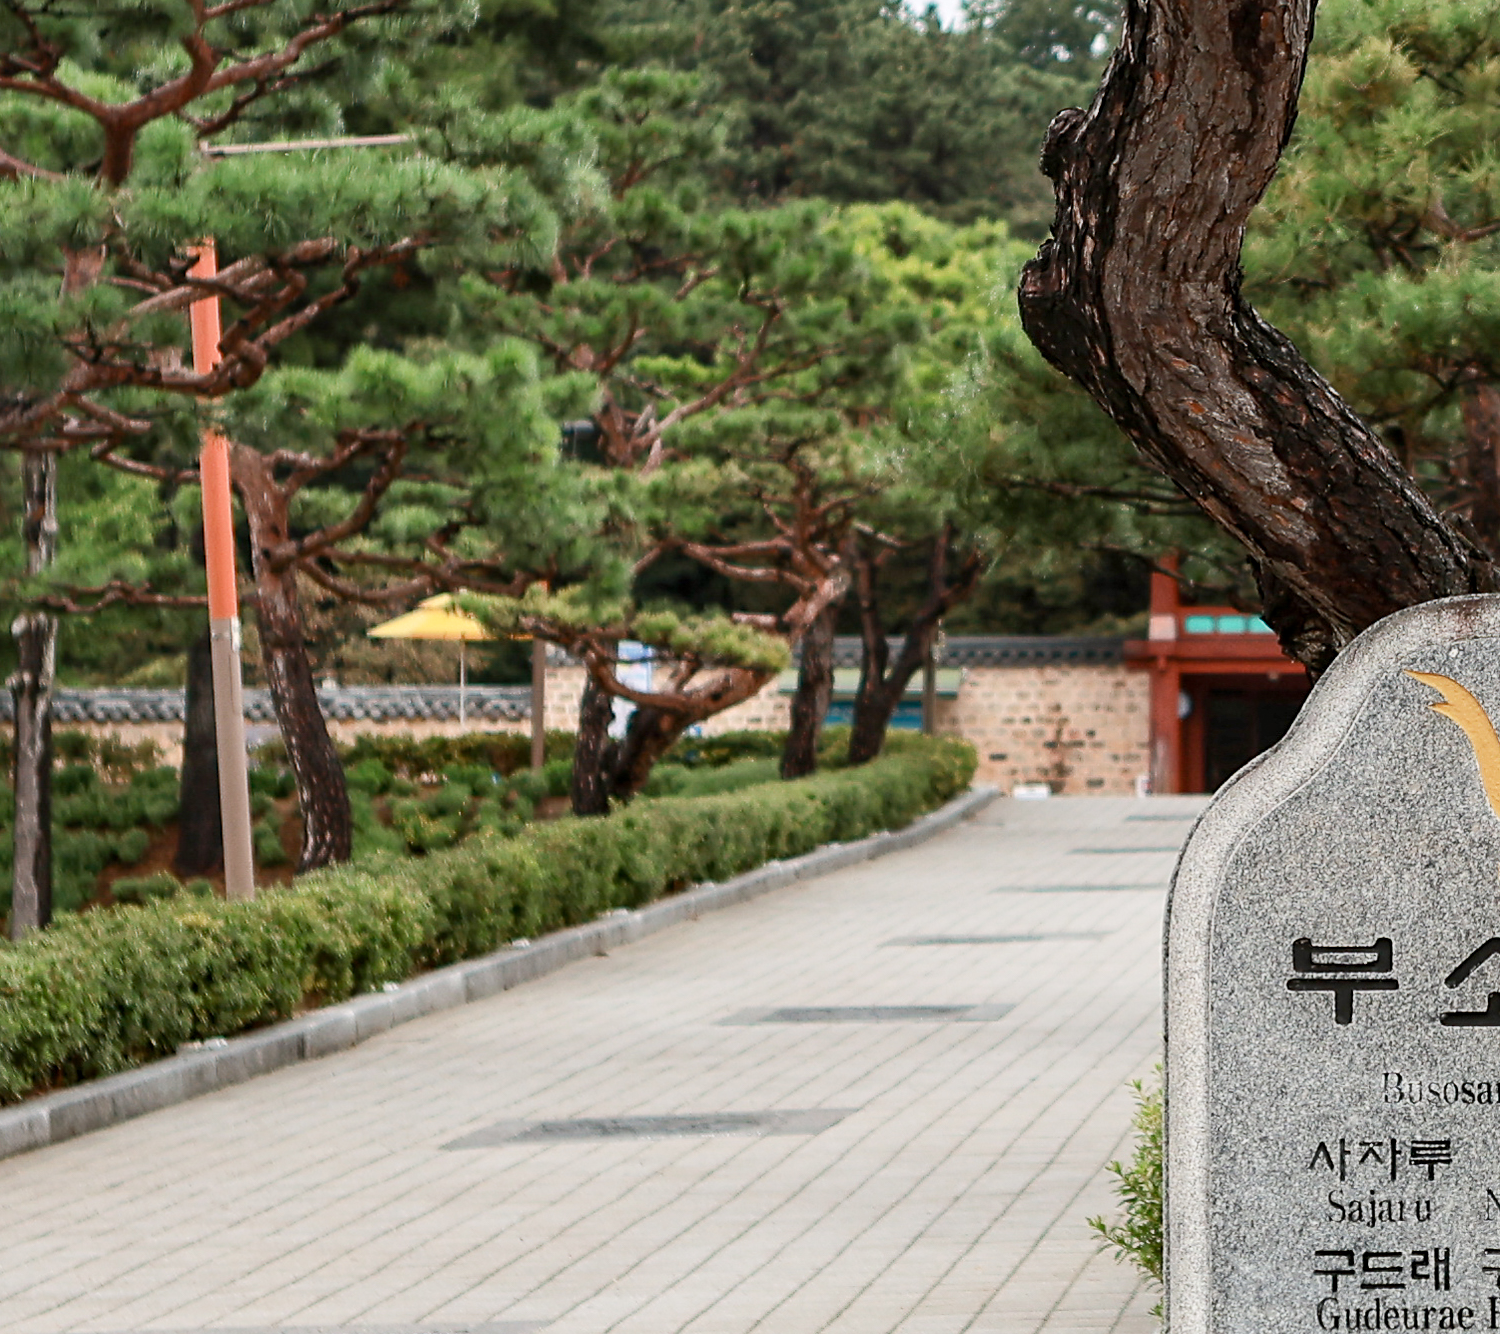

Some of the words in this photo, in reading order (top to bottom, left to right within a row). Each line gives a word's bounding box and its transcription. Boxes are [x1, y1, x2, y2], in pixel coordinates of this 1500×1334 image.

[1308, 1137, 1453, 1181] 사자루
[1327, 1189, 1433, 1228] Sajaru
[1313, 1247, 1450, 1292] 구드래
[1316, 1296, 1474, 1332] Gudeurae
